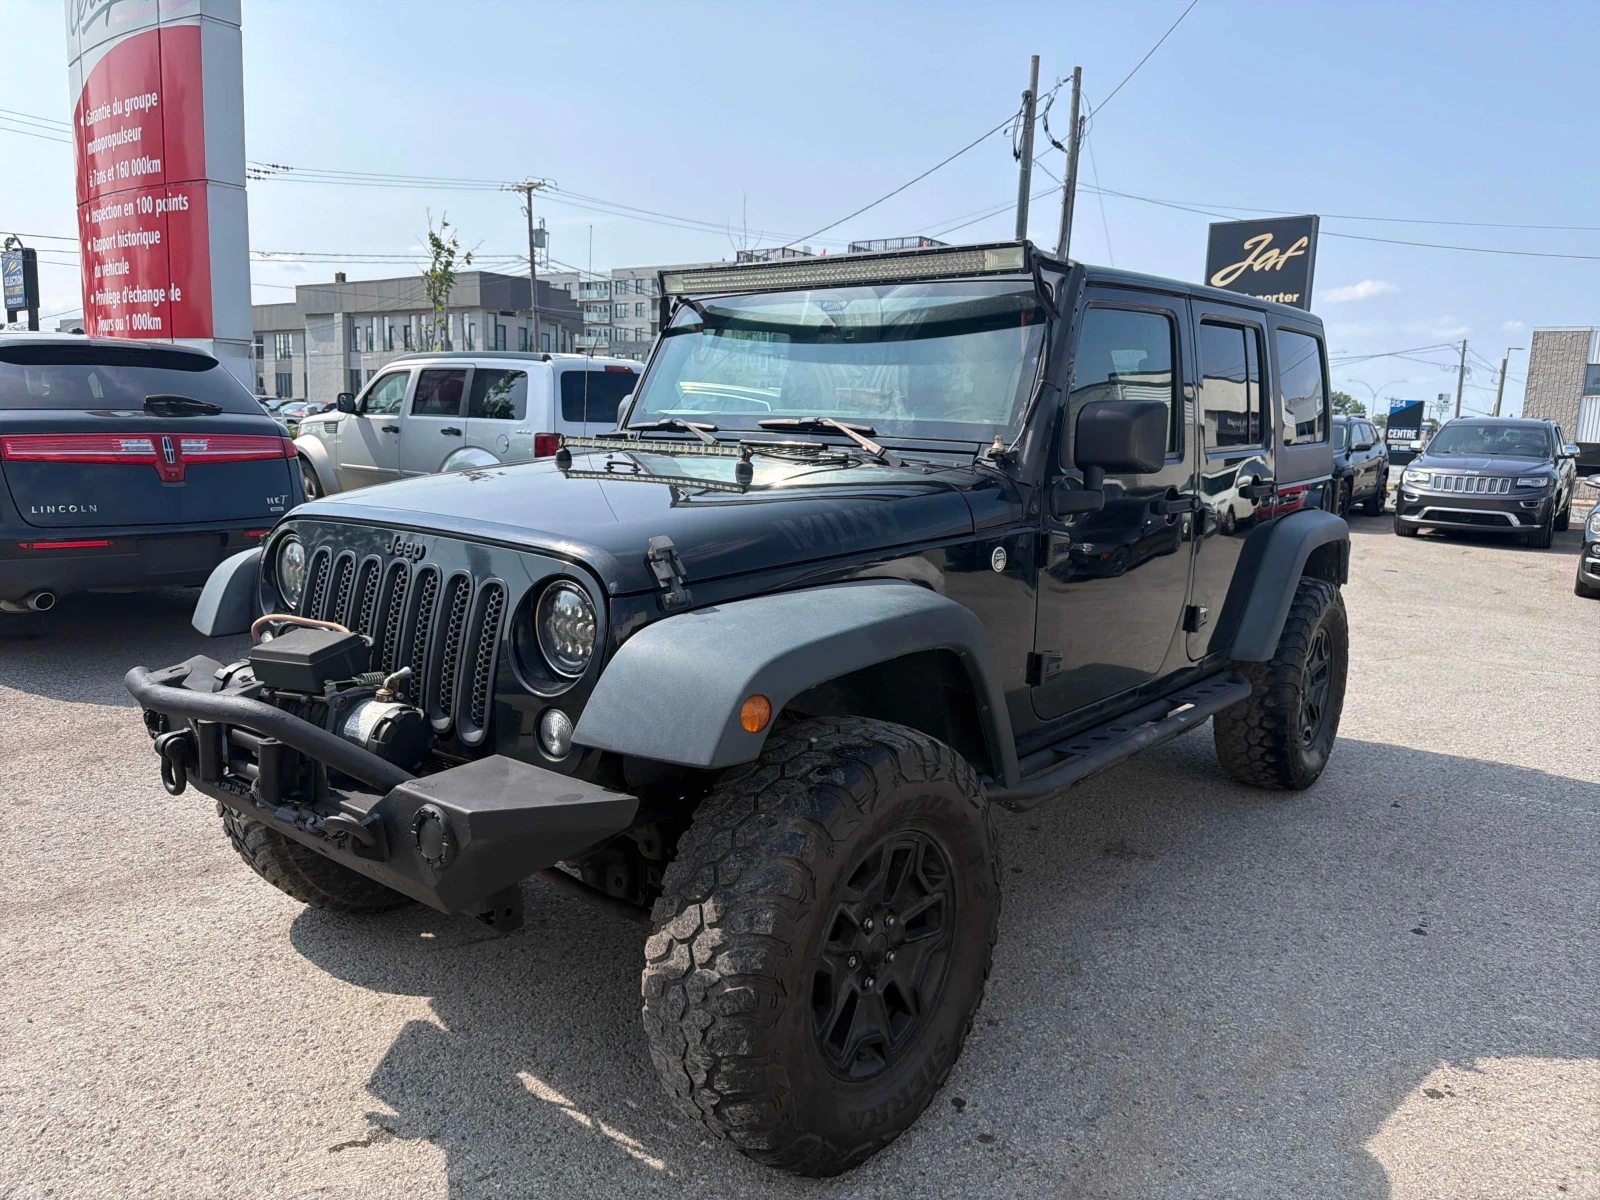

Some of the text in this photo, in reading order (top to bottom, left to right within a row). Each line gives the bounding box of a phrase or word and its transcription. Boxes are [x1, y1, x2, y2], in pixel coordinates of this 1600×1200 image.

[86, 92, 158, 126] Garantie du groupe
[87, 126, 142, 155] motopropulseur
[107, 165, 115, 182] et
[116, 160, 129, 179] 160
[131, 155, 161, 176] 000km
[91, 192, 189, 226] Inspection en 100 points
[92, 227, 161, 256] Rapport historique
[94, 256, 130, 278] du véhicule
[1210, 233, 1308, 287] Jaf
[95, 282, 181, 309] Privilège d'échange de
[115, 318, 124, 331] ou
[132, 312, 162, 331] 000km
[1390, 400, 1406, 408] 254
[1387, 429, 1418, 439] CENTRE
[31, 504, 98, 514] LINCOLN
[384, 534, 425, 563] Jeep
